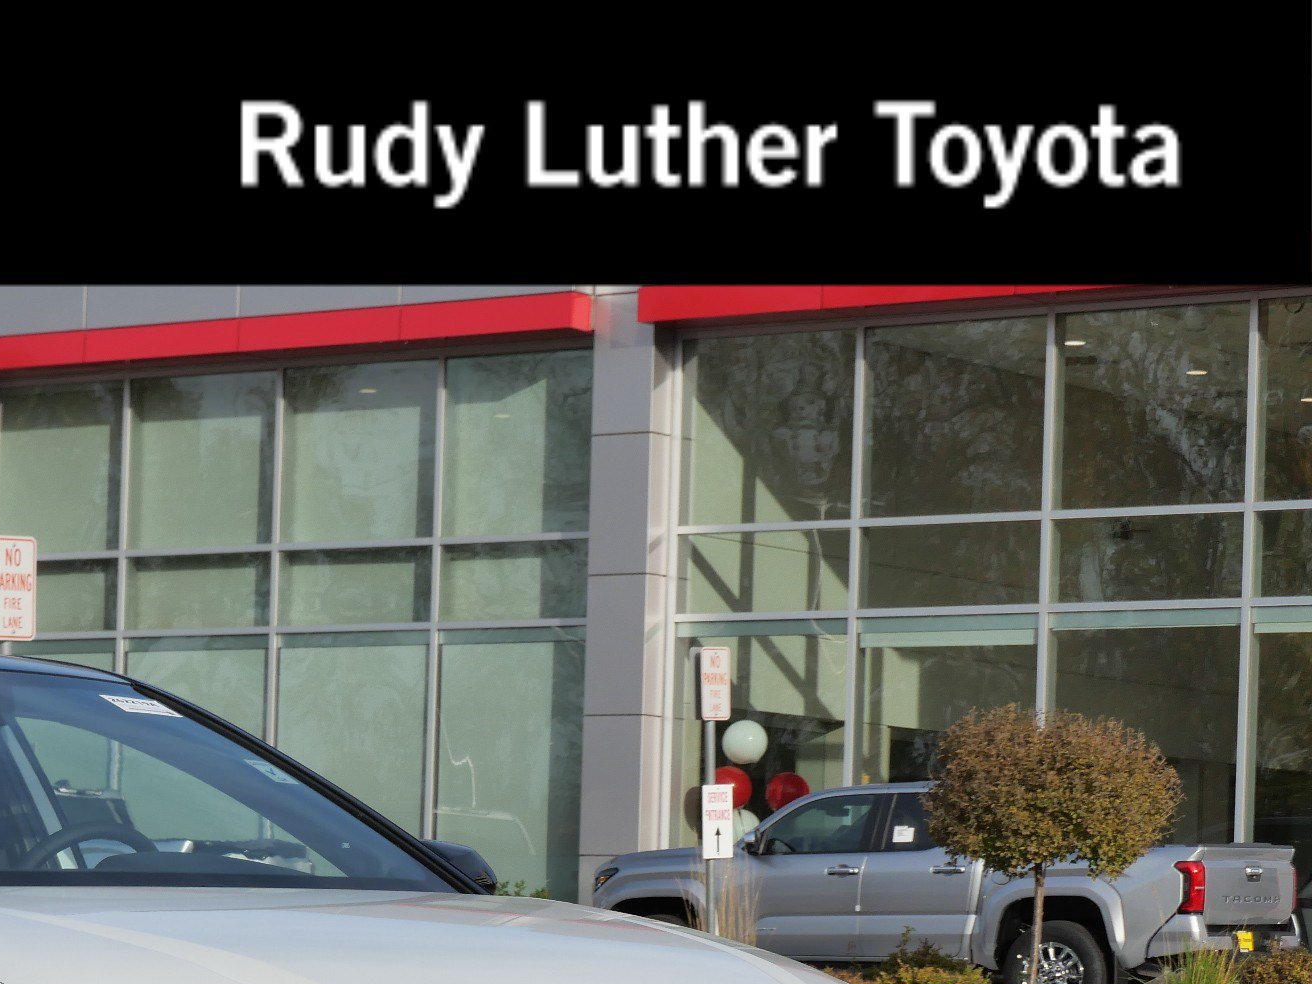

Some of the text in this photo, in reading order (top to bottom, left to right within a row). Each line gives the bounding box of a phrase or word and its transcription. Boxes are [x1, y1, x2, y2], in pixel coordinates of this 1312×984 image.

[4, 547, 22, 567] NO
[4, 597, 23, 610] FIRE
[3, 616, 23, 629] LANE
[710, 655, 721, 668] NO
[1222, 895, 1281, 904] TACOMA
